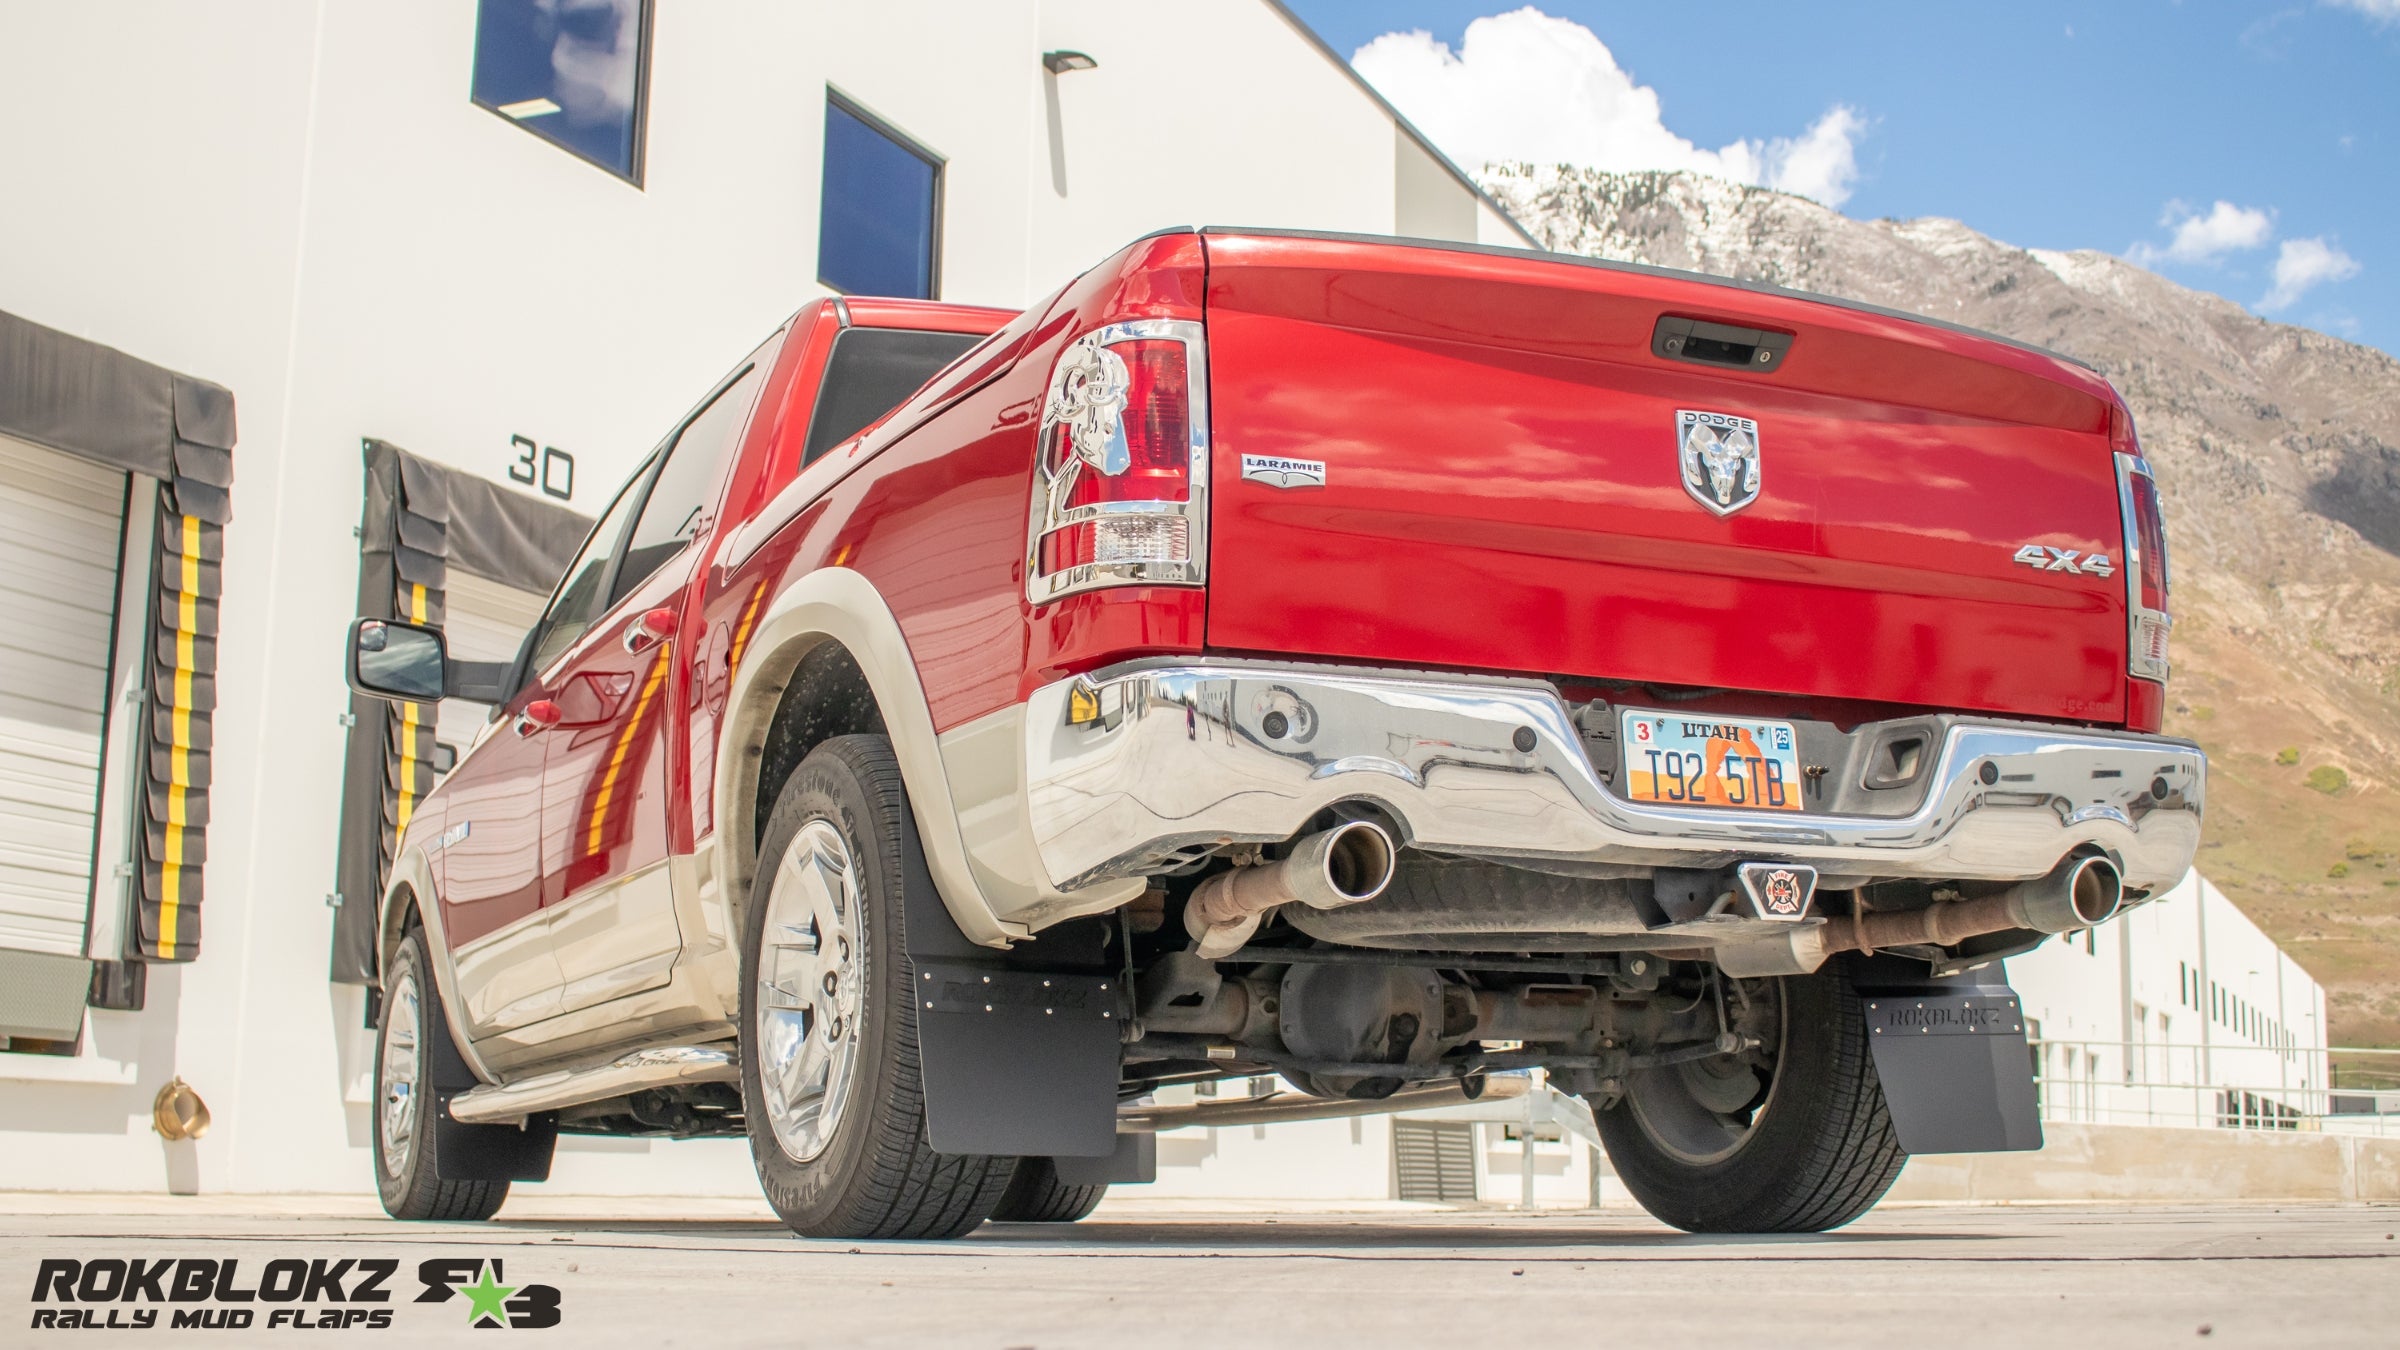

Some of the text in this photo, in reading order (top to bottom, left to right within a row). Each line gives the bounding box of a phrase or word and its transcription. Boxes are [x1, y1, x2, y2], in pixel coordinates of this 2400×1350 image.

[1684, 412, 1752, 431] DODGE
[510, 435, 574, 500] 30
[1246, 458, 1322, 472] LARAMIE
[1637, 722, 1650, 740] 3
[1681, 722, 1740, 743] UTAH
[1775, 729, 1789, 744] 25
[1889, 1008, 2000, 1026] ROKBLOKZ
